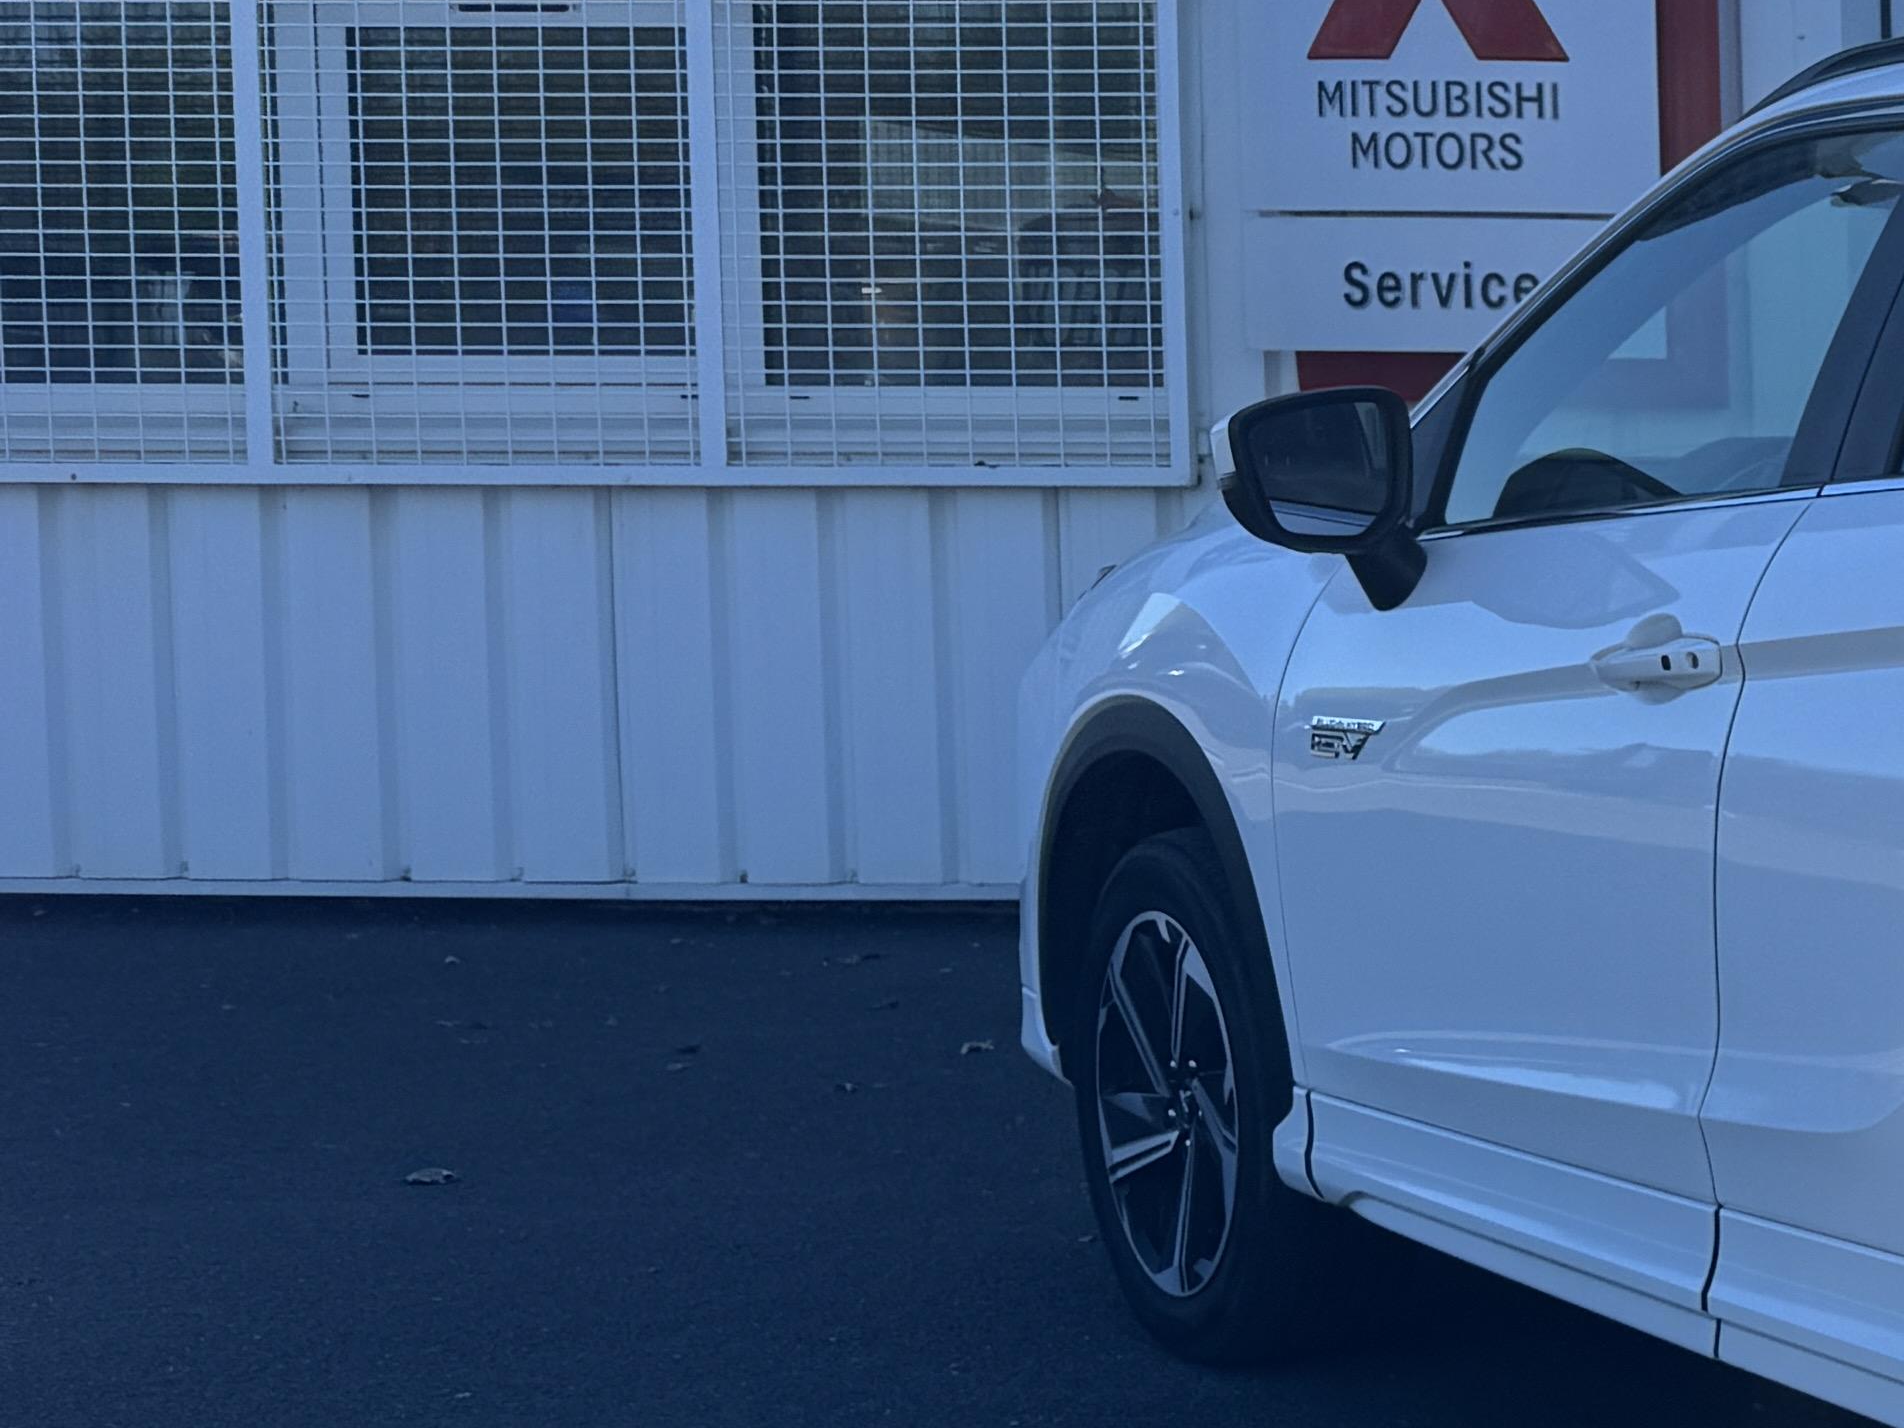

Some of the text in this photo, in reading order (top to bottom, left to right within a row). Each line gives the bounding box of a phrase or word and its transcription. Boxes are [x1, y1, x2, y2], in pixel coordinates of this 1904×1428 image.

[1317, 79, 1560, 121] MITSUBISHI
[1350, 131, 1525, 172] MOTORS
[1343, 260, 1543, 310] Service
